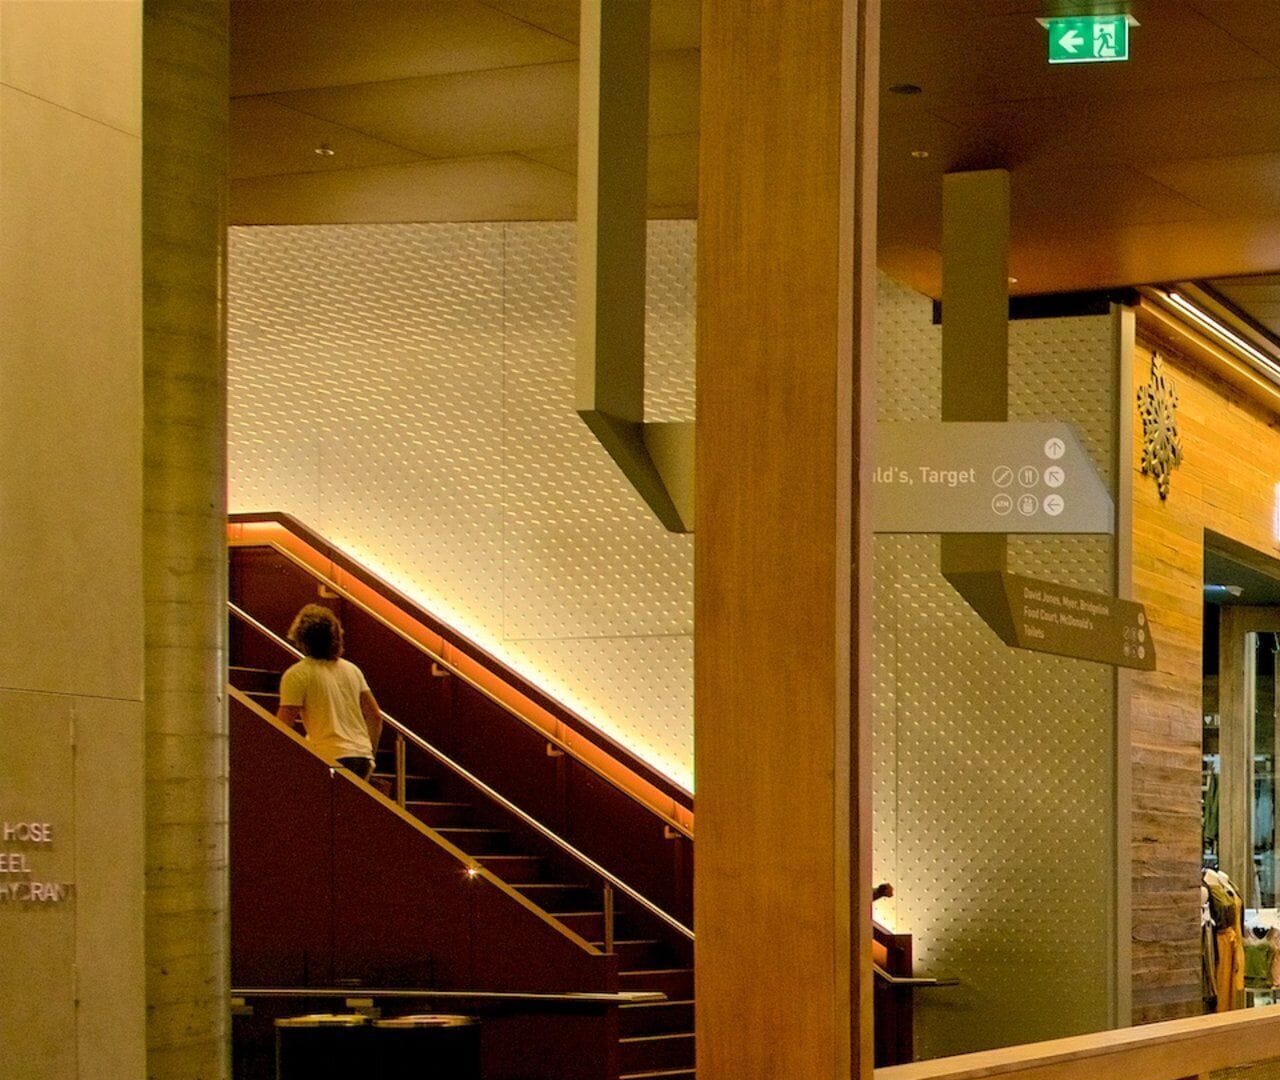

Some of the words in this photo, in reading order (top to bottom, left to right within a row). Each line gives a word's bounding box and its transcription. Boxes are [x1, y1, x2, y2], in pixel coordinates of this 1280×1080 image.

[872, 466, 913, 485] ld's,
[918, 466, 976, 487] Target
[1023, 605, 1040, 618] Food
[3, 822, 52, 842] HOSE
